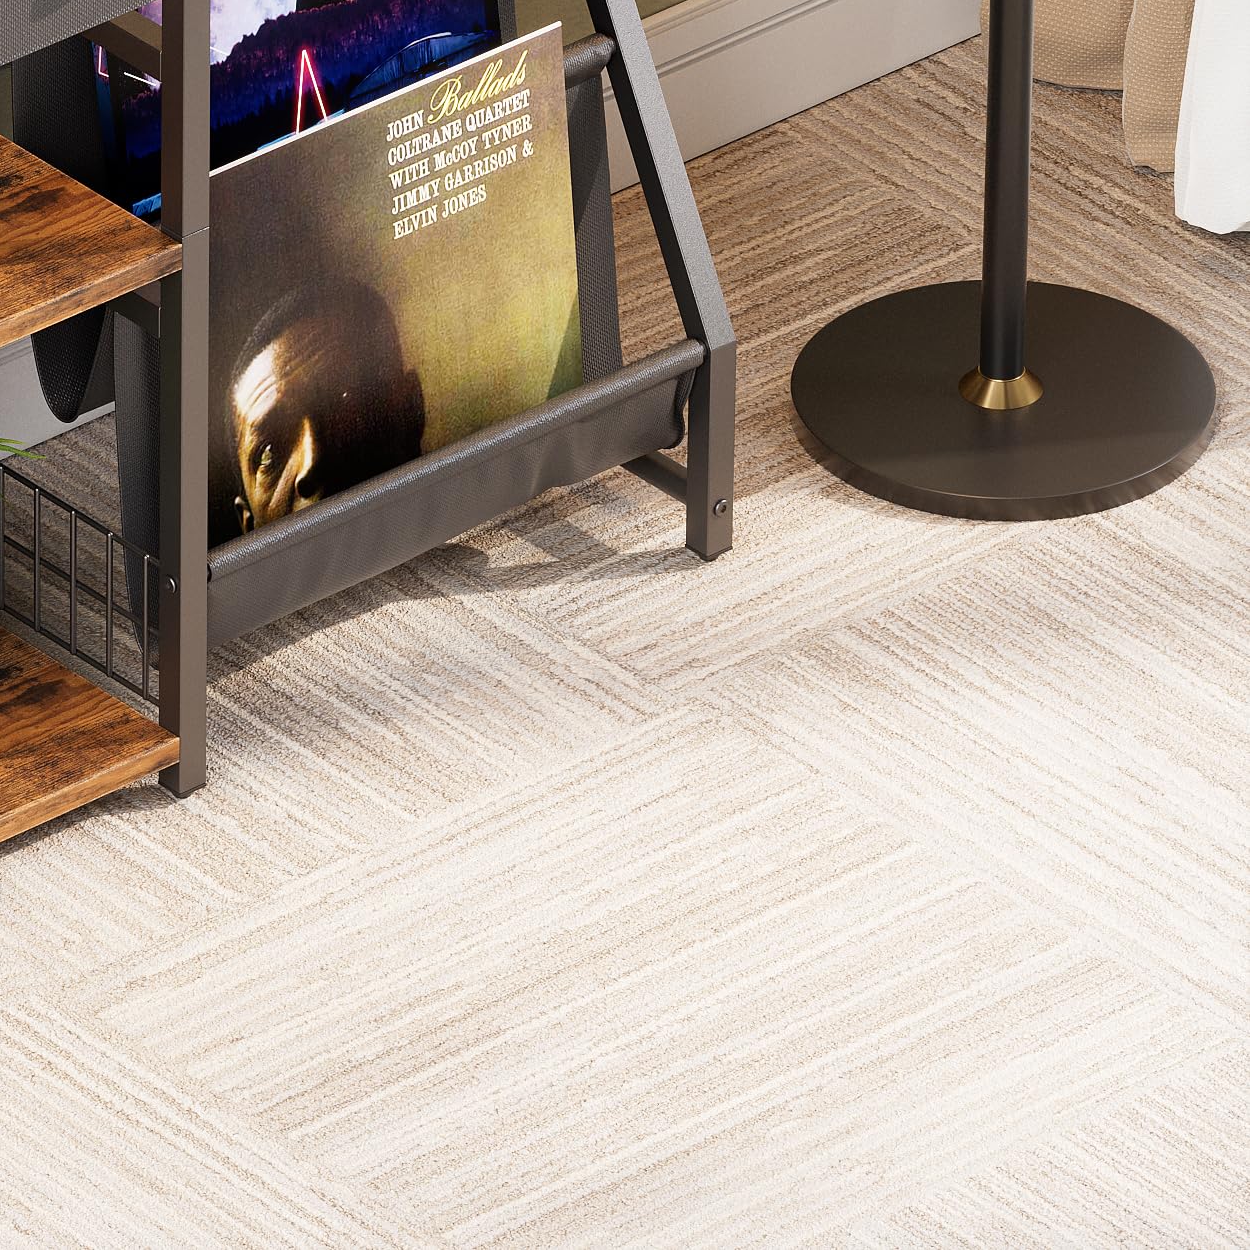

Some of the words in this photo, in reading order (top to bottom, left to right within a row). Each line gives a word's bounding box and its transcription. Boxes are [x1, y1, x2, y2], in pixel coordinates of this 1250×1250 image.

[427, 50, 528, 124] Ballads
[386, 110, 424, 142] JOHN
[388, 118, 462, 166] COLTRANE
[466, 89, 530, 132] QUARTET
[389, 160, 431, 190] WITH
[433, 136, 479, 171] McCOY
[482, 114, 533, 150] TYNER
[392, 178, 441, 215] JIMMY
[444, 145, 517, 191] GARRISON
[522, 139, 534, 158] &
[392, 205, 438, 240] ELVIN
[441, 184, 487, 219] JONES
